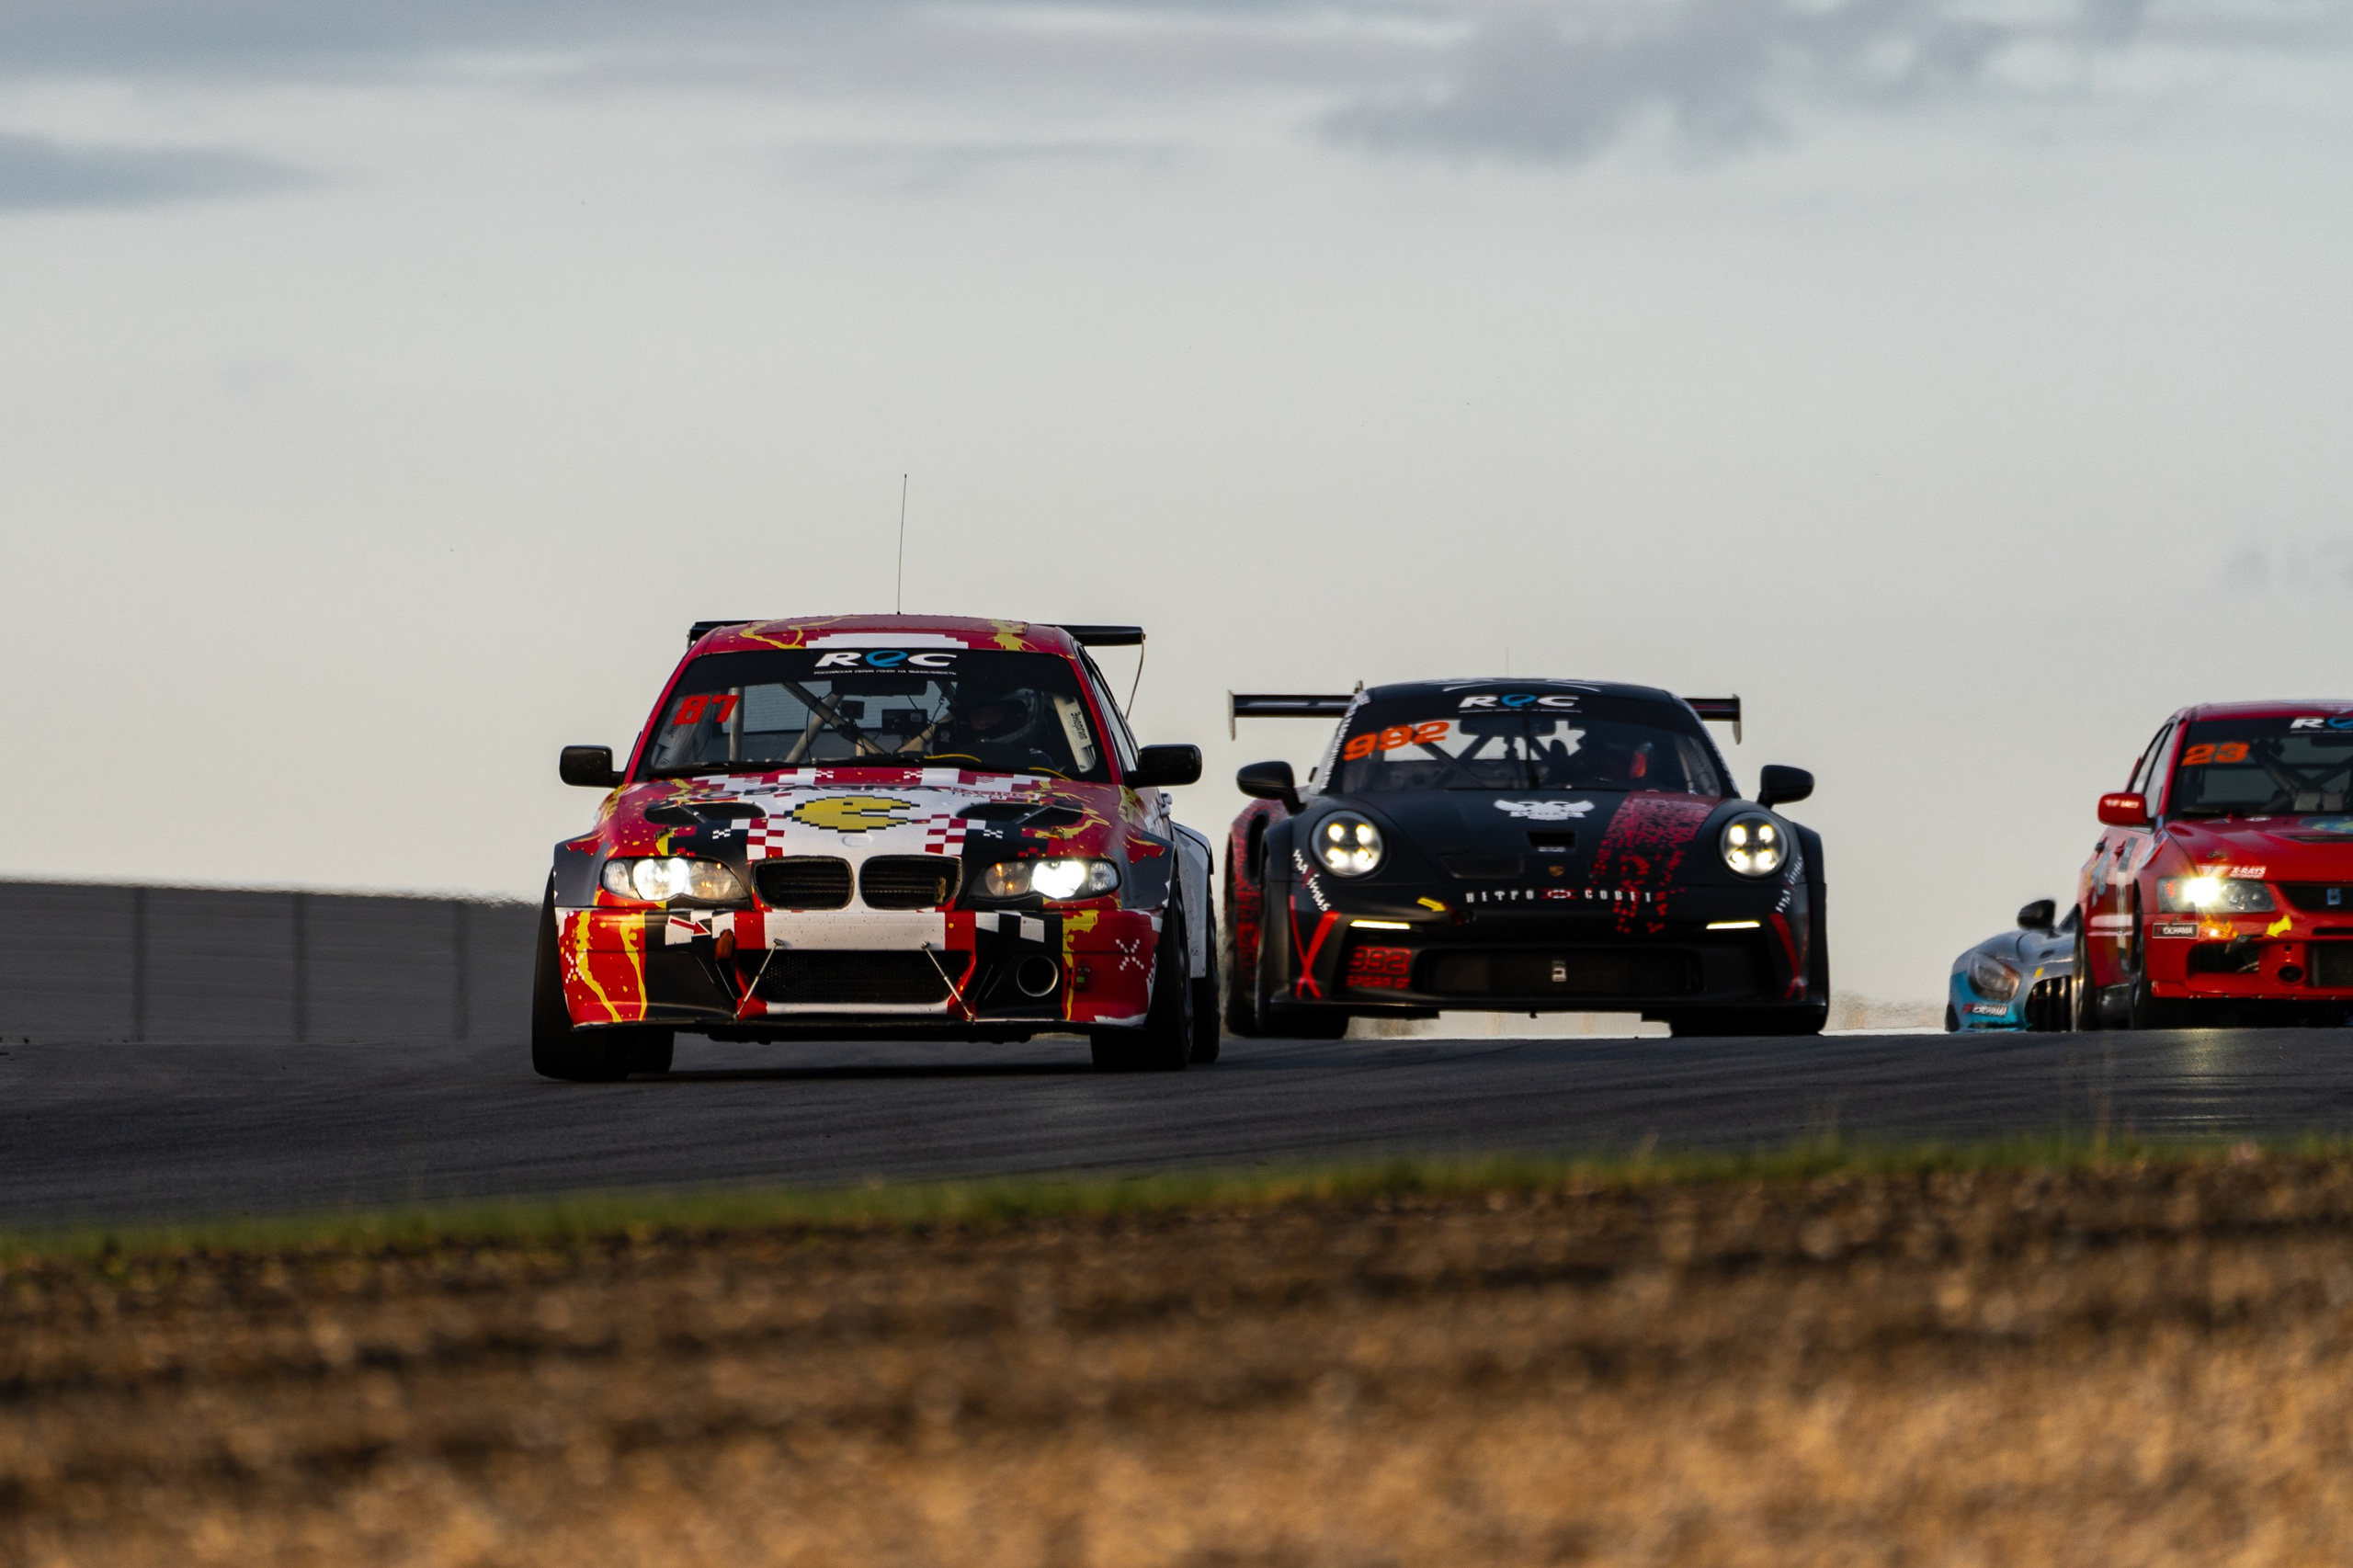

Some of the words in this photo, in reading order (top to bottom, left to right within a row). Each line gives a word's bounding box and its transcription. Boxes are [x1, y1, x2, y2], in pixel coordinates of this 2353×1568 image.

[673, 694, 740, 725] 87
[1070, 710, 1088, 741] Энергия
[1342, 721, 1450, 762] 992
[2180, 742, 2250, 767] 23
[1349, 946, 1411, 975] 992
